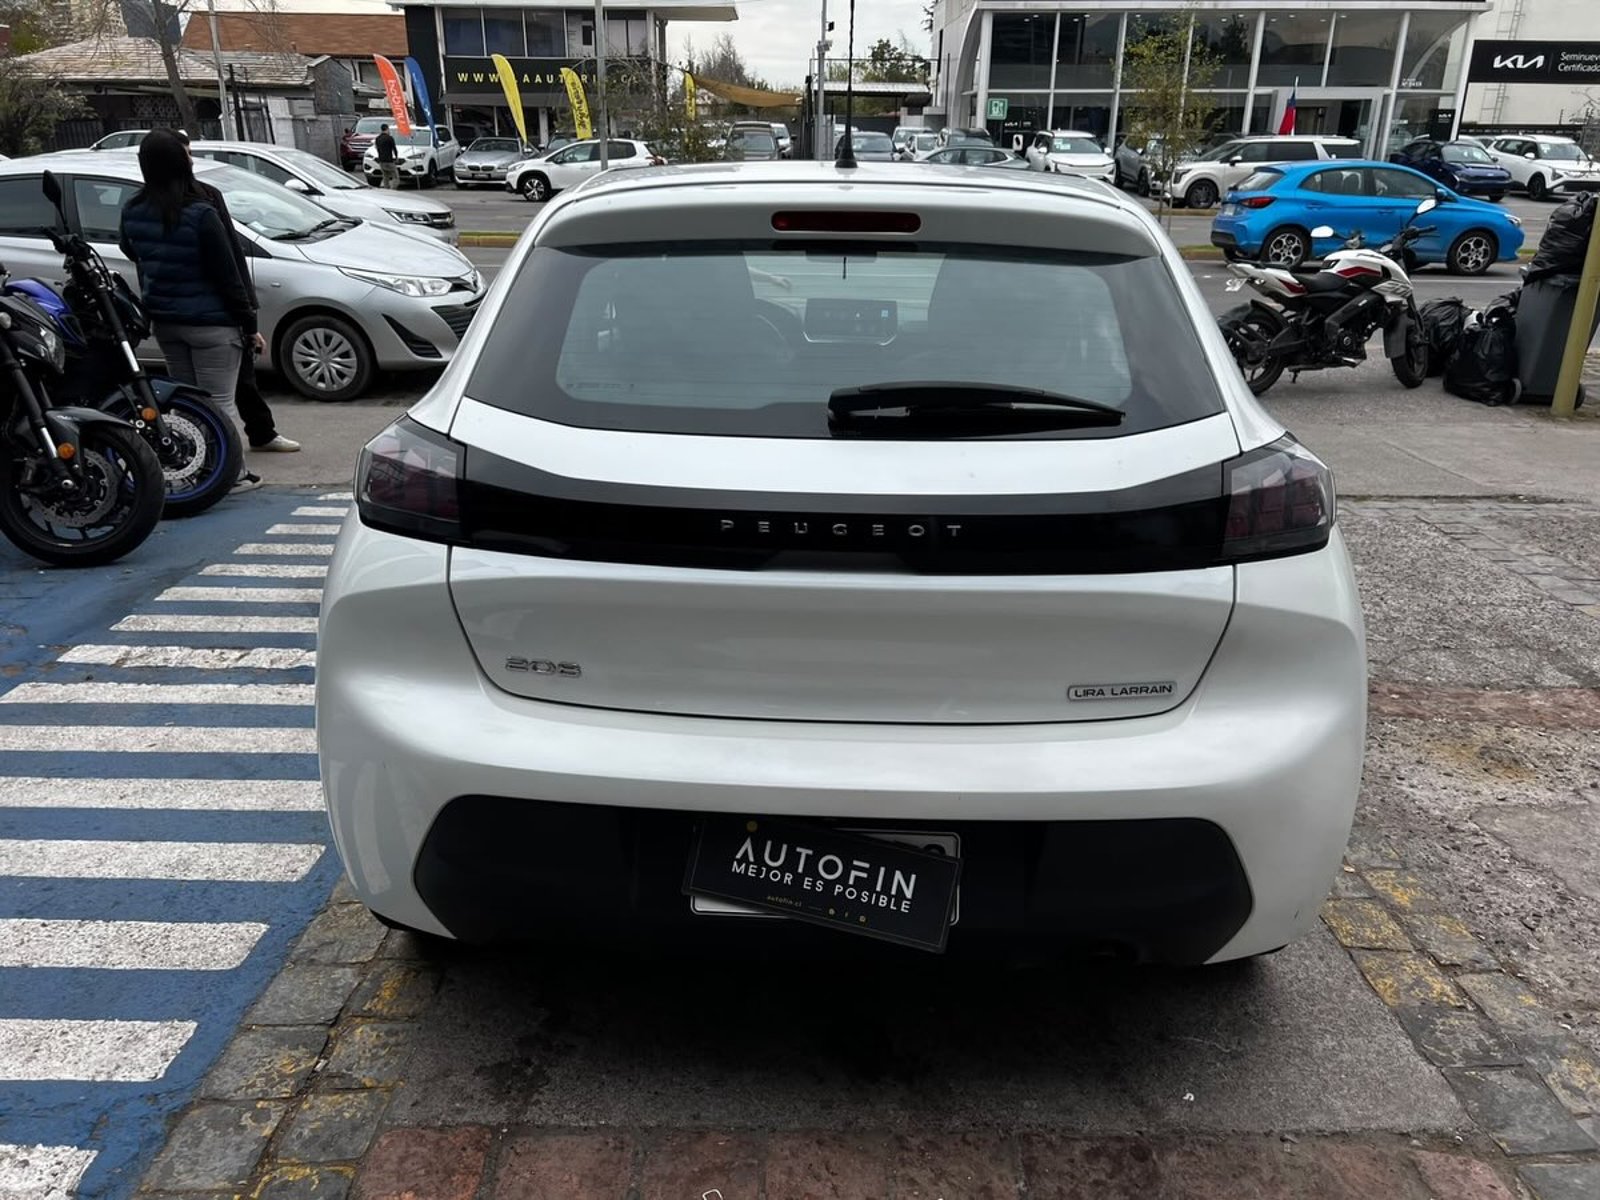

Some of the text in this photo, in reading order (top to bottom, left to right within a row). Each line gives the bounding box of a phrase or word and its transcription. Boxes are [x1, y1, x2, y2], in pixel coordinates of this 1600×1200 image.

[720, 519, 962, 537] PEUGEOT
[1074, 685, 1173, 698] LIRA LARRAIN
[735, 837, 917, 899] AUTOFIN
[731, 861, 912, 913] MEJOR ES POSIBLE
